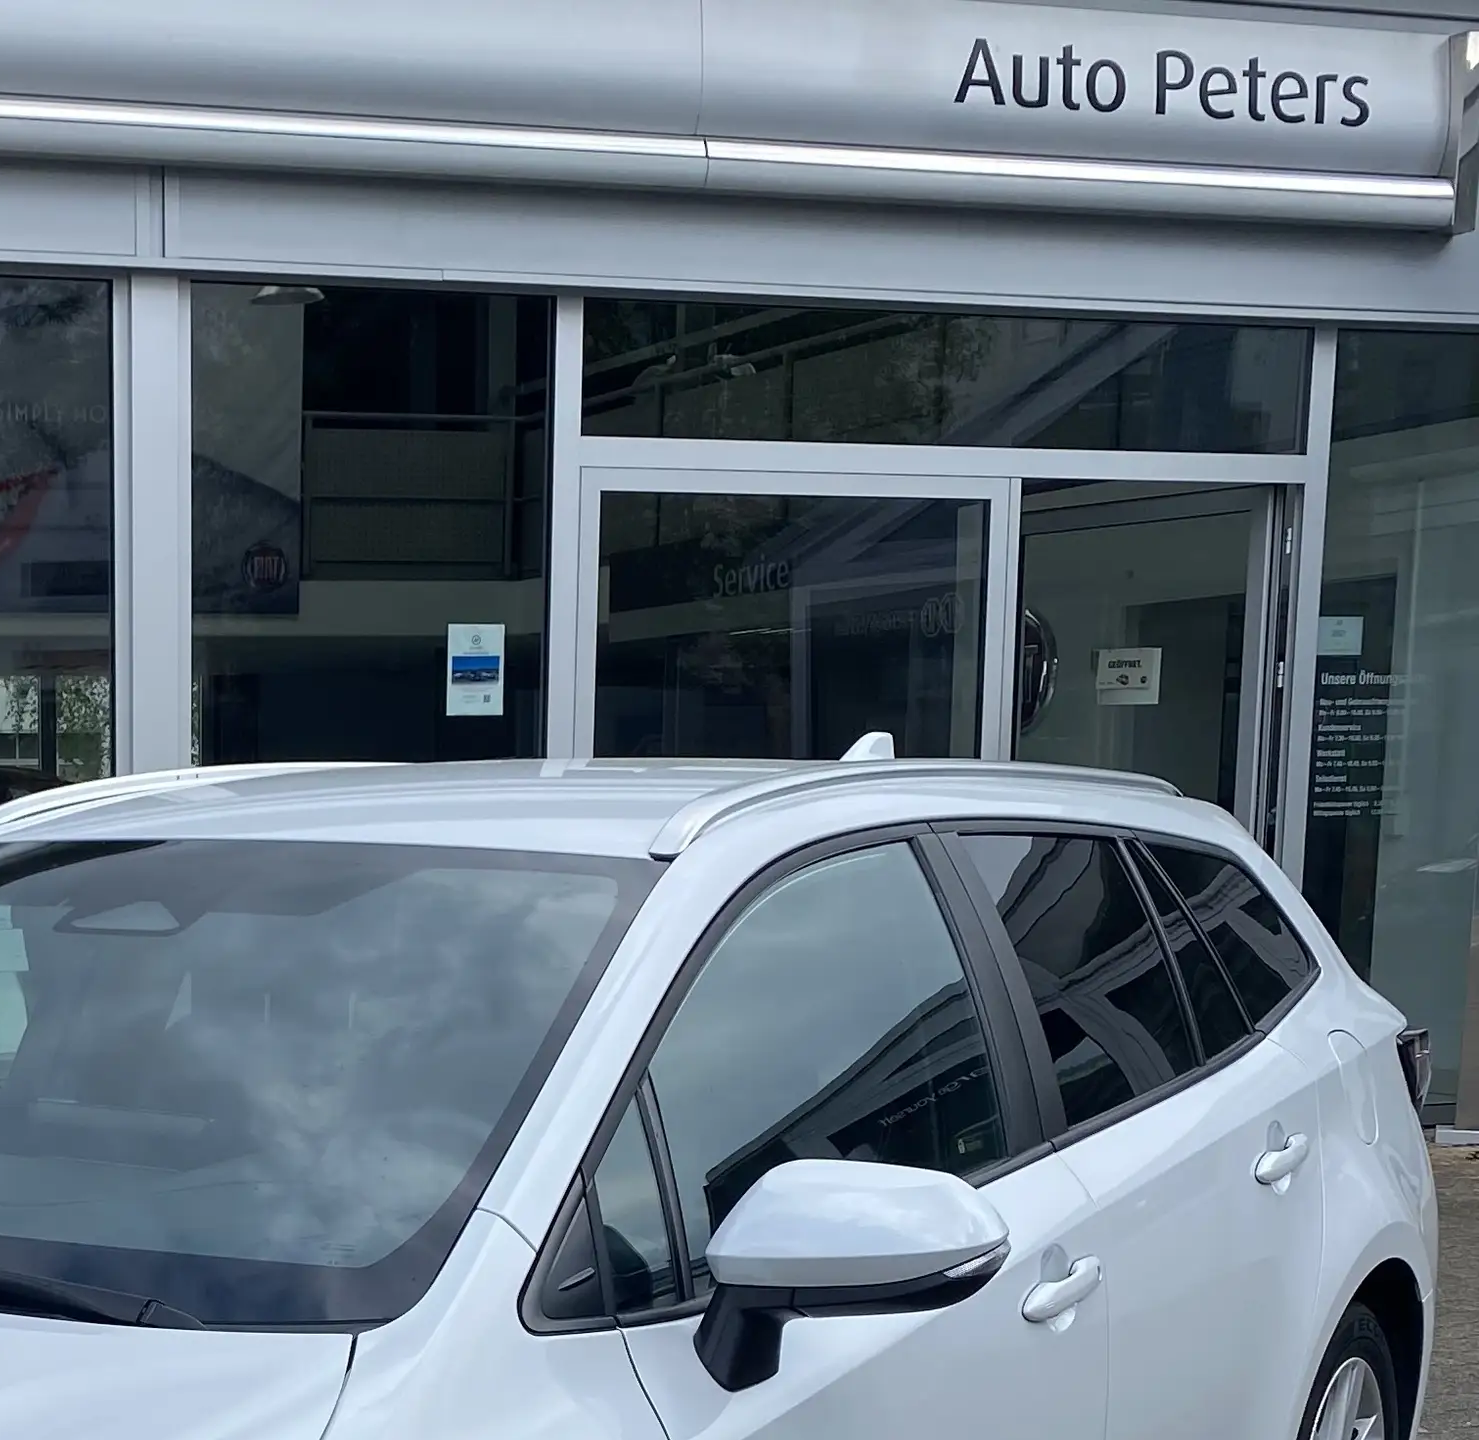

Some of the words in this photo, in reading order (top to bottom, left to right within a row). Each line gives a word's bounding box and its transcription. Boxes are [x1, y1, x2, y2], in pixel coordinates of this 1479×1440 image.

[954, 38, 1127, 113] Auto
[1155, 49, 1370, 128] Peters
[713, 553, 790, 598] Service
[1321, 673, 1356, 685] Unsere
